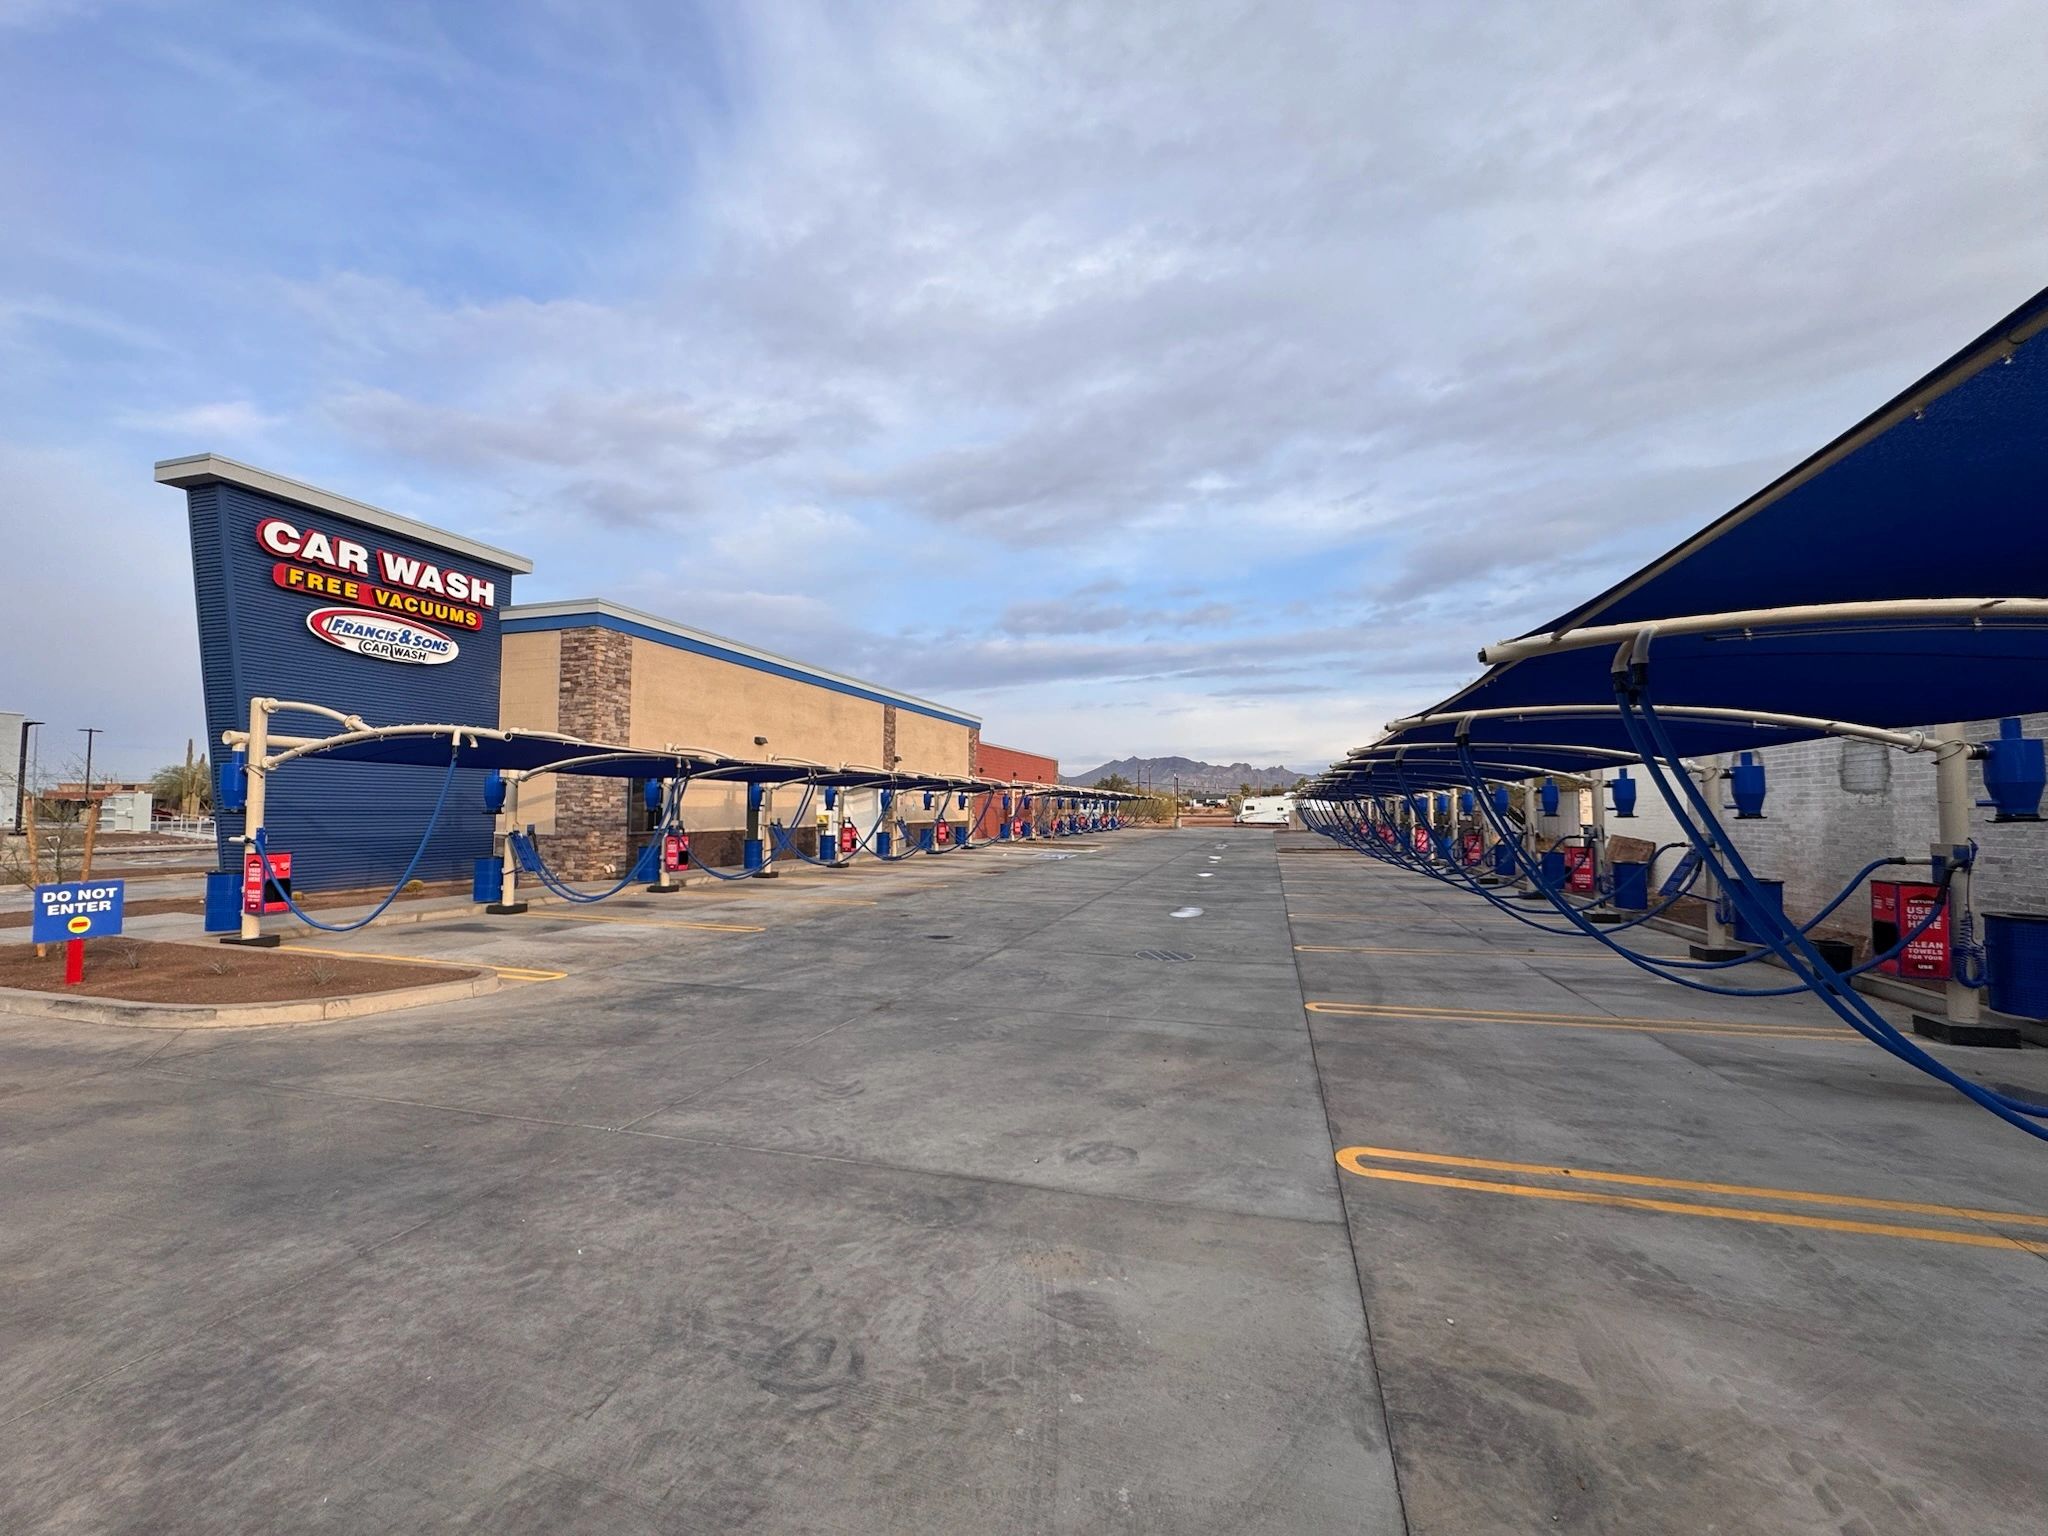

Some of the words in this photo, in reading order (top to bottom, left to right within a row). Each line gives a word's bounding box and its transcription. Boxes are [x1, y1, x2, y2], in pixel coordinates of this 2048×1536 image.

[263, 520, 369, 575] CAR
[382, 551, 495, 607] WASH
[288, 567, 359, 599] FREE
[374, 589, 477, 627] VACUUMS
[363, 641, 389, 655] CAR
[393, 645, 427, 662] WASH
[42, 891, 72, 904] DO
[77, 886, 118, 901] NOT
[47, 900, 111, 916] ENTER
[1907, 941, 1943, 949] CLEAN
